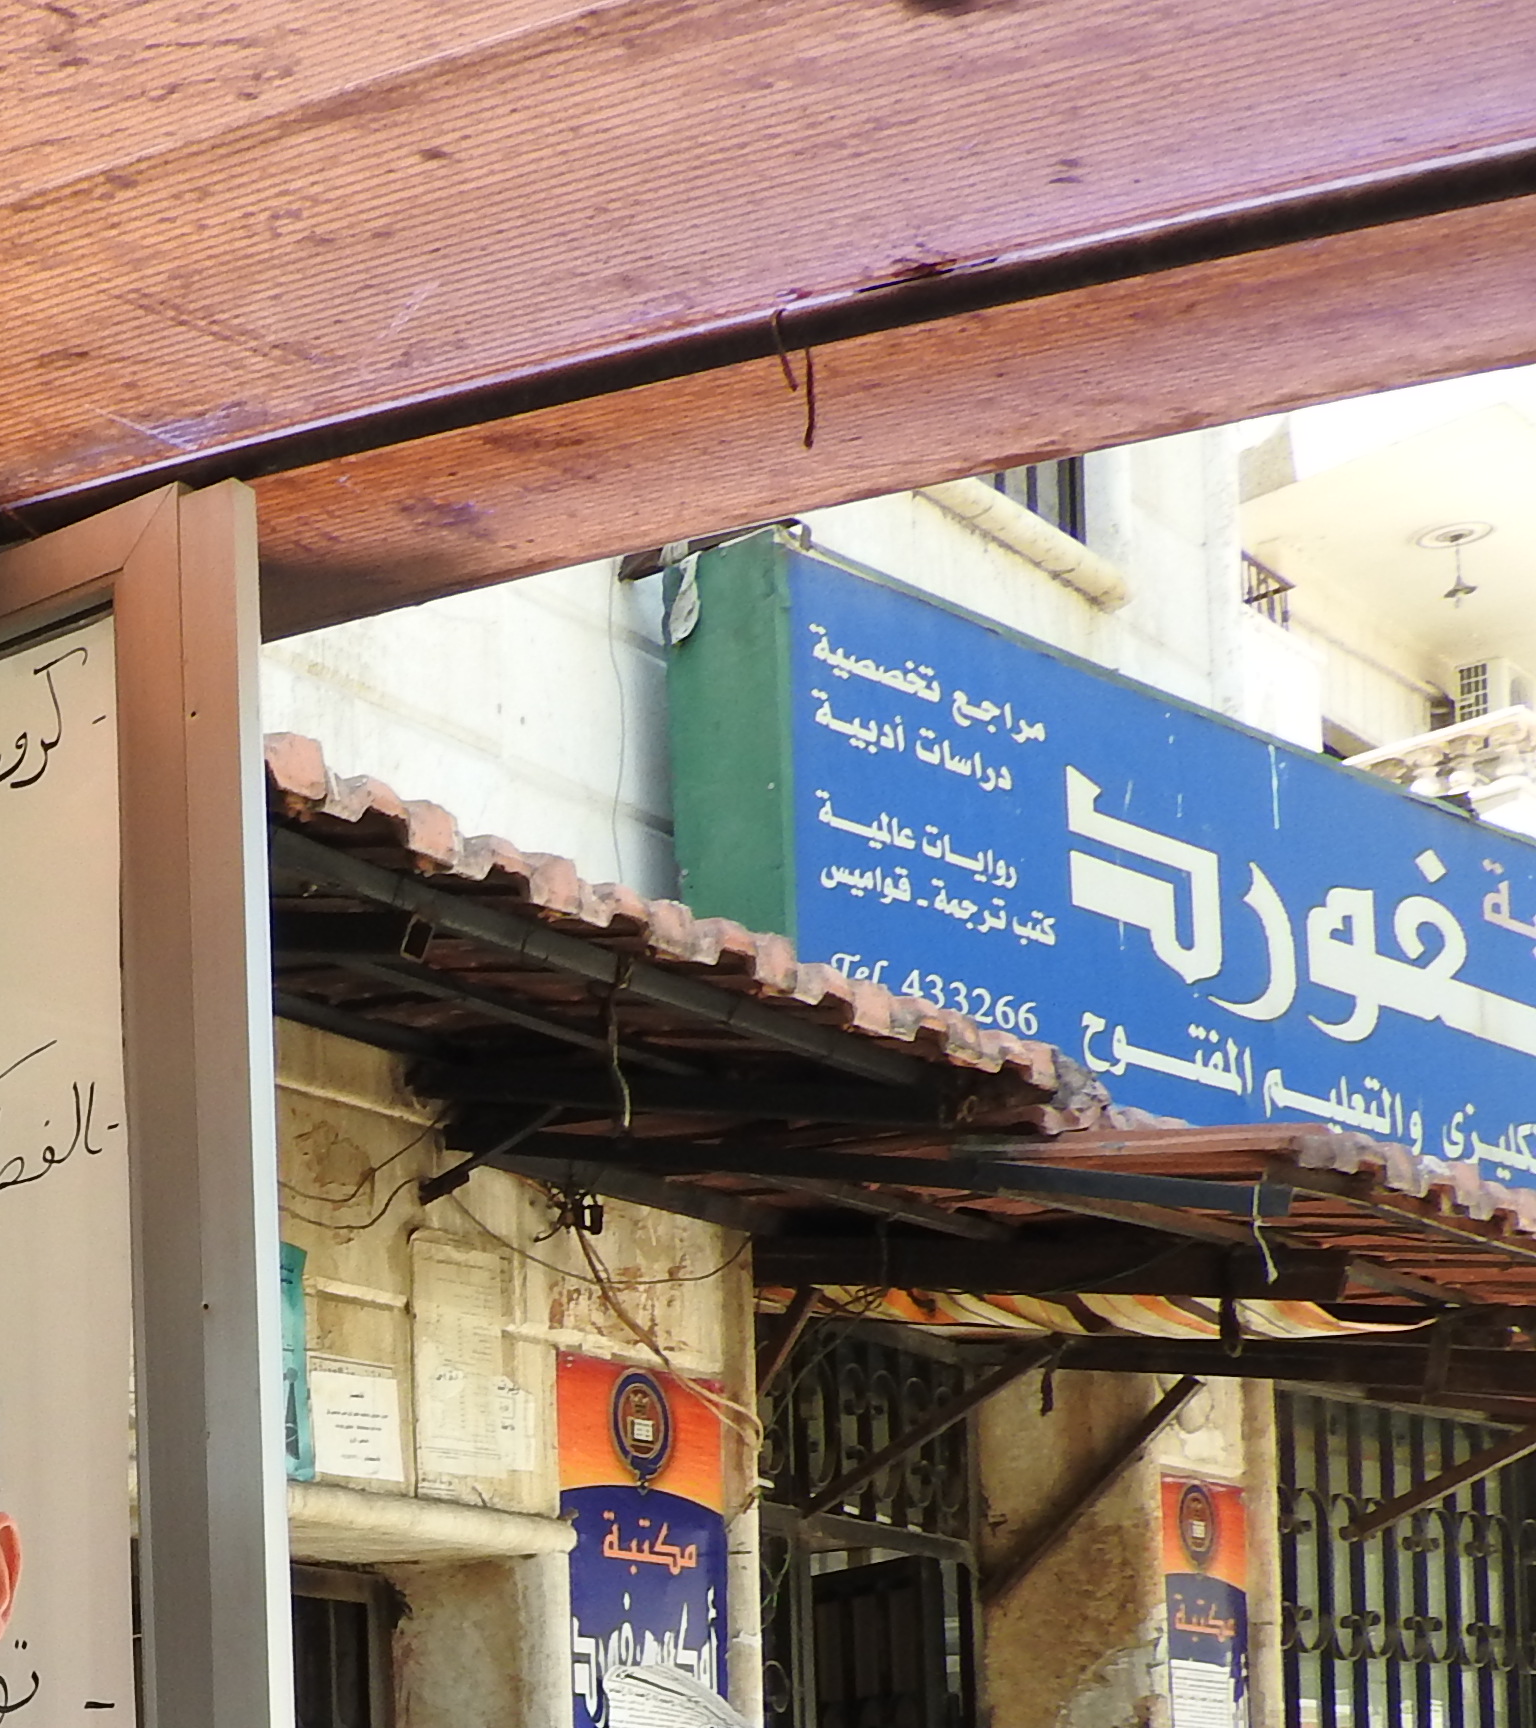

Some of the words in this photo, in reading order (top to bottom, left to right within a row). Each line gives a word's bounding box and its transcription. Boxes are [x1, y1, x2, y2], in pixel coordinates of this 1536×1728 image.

[809, 623, 941, 703] تخصصية
[811, 689, 905, 753] أدبية
[953, 690, 1046, 743] مراجع
[915, 727, 1012, 791] دراسات
[816, 790, 915, 849] عالمية
[821, 864, 911, 904] قواميس
[922, 825, 1017, 888] روايات
[932, 879, 1006, 933] ترجمة
[1012, 909, 1056, 946] كتب
[1066, 766, 1536, 1058] فورد
[901, 969, 1038, 1036] 433266
[1081, 1011, 1253, 1096] المفتوح
[1262, 1068, 1423, 1155] والتعليم
[603, 1510, 697, 1575] مكتبة
[1173, 1593, 1237, 1643] مكتبة
